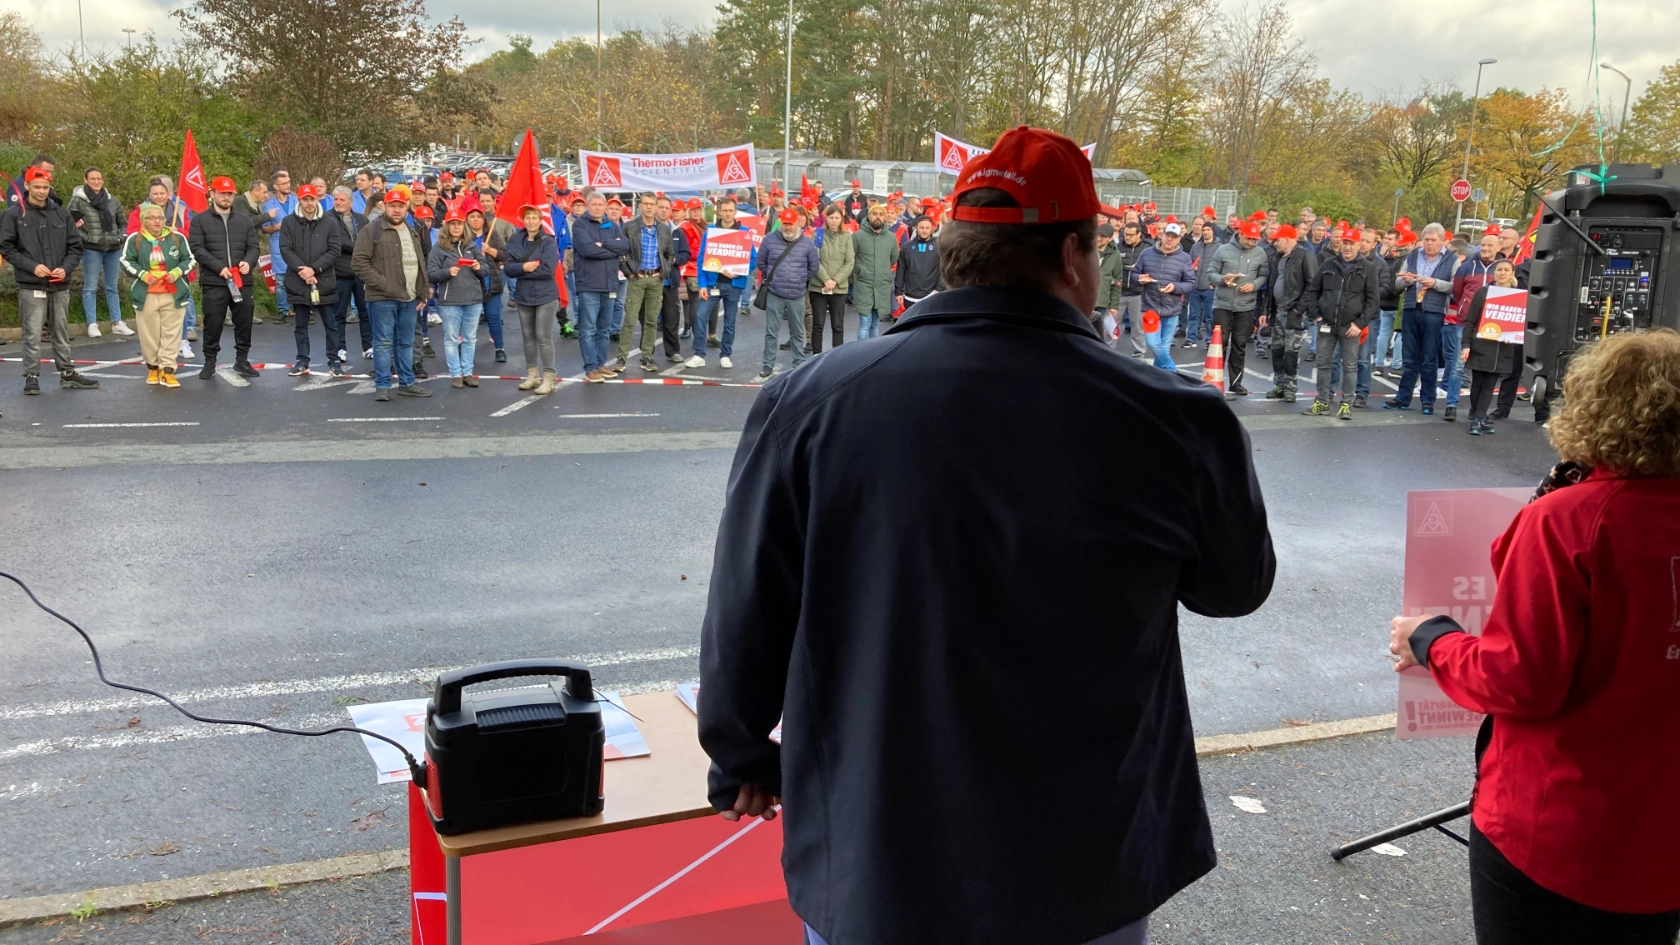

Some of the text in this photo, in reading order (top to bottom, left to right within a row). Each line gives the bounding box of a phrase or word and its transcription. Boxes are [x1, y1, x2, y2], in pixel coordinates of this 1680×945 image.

[633, 166, 705, 176] SCIENTIFIC
[1453, 186, 1470, 195] STOP
[707, 247, 750, 259] VERDIENT!
[1500, 305, 1523, 313] HABEN
[1485, 310, 1526, 323] VERDIE
